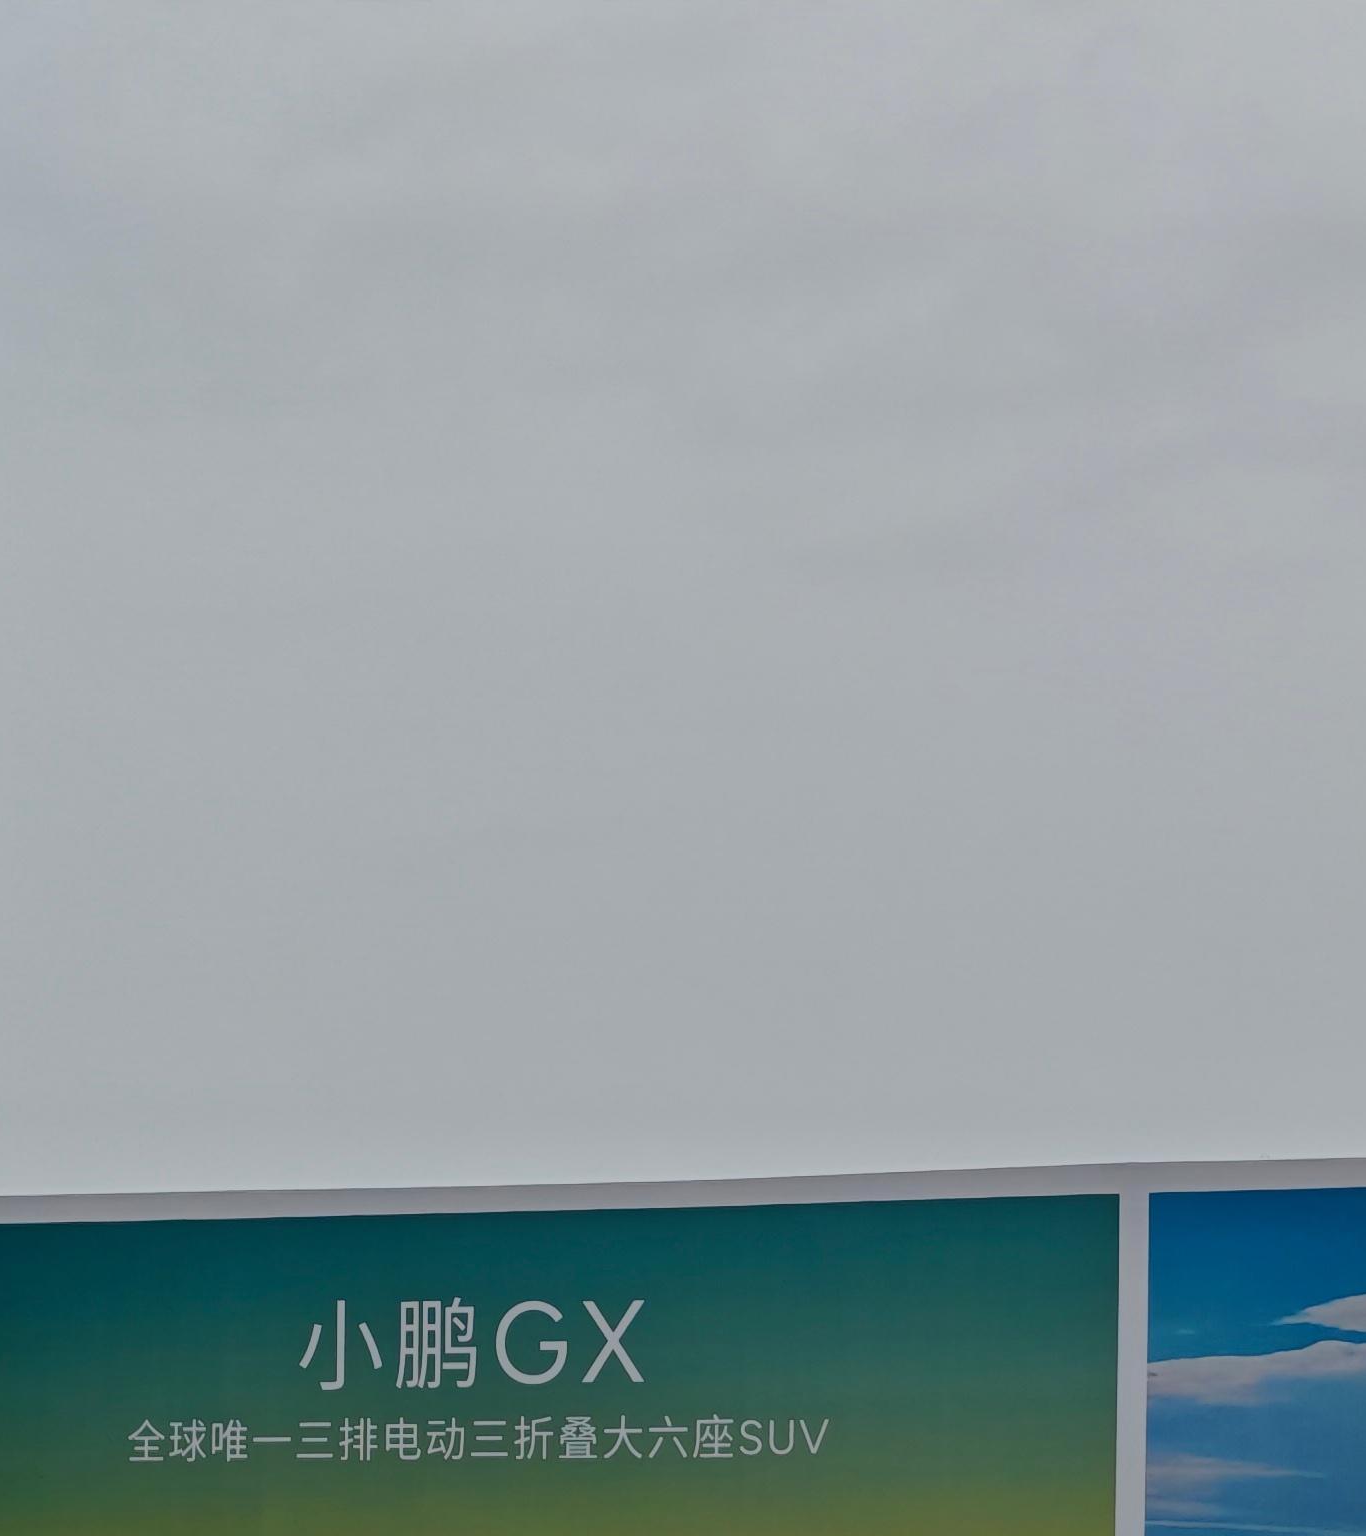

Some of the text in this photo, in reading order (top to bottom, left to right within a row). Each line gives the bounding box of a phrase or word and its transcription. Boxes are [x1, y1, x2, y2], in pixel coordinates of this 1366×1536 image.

[298, 1297, 646, 1390] 小鹏GX
[127, 1414, 830, 1464] 全球唯一三排电动三折叠大六座SUV
